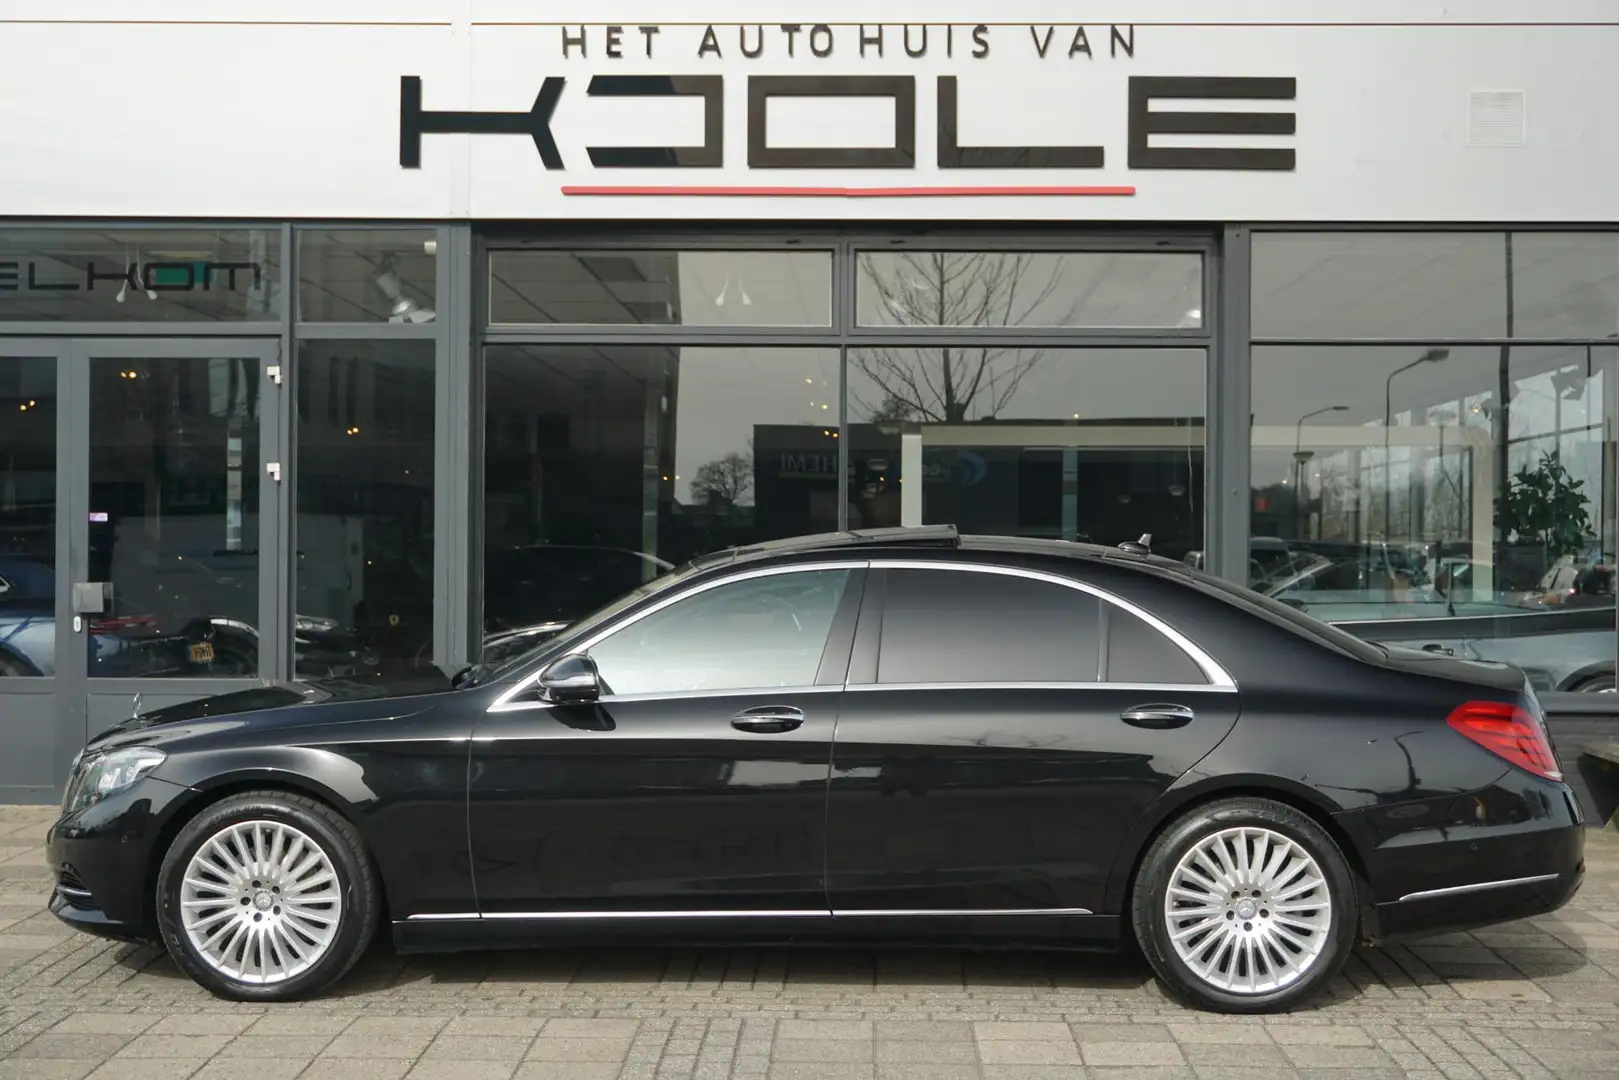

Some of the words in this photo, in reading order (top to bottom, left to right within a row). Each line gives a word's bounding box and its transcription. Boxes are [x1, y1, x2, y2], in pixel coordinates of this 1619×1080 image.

[562, 24, 661, 59] HET
[698, 24, 991, 59] AUTOHUIS
[1030, 24, 1135, 60] VAN
